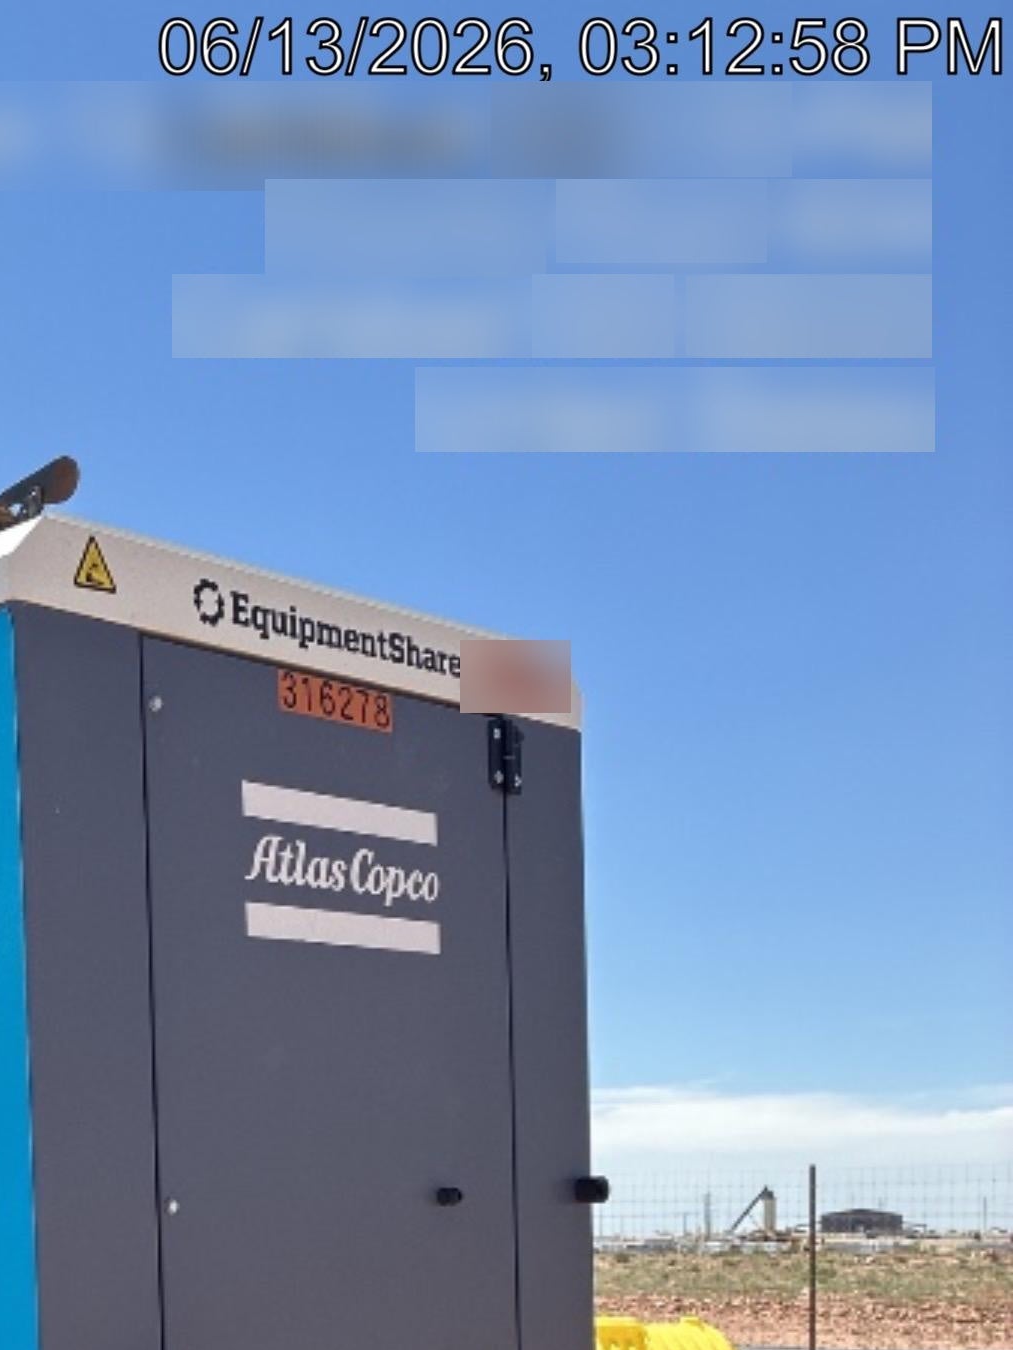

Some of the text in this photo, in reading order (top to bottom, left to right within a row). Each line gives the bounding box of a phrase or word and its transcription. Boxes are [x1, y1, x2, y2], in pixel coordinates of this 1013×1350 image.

[230, 589, 461, 678] EquipmentShare
[280, 671, 392, 728] 316278
[244, 834, 440, 907] Atlas Copco
